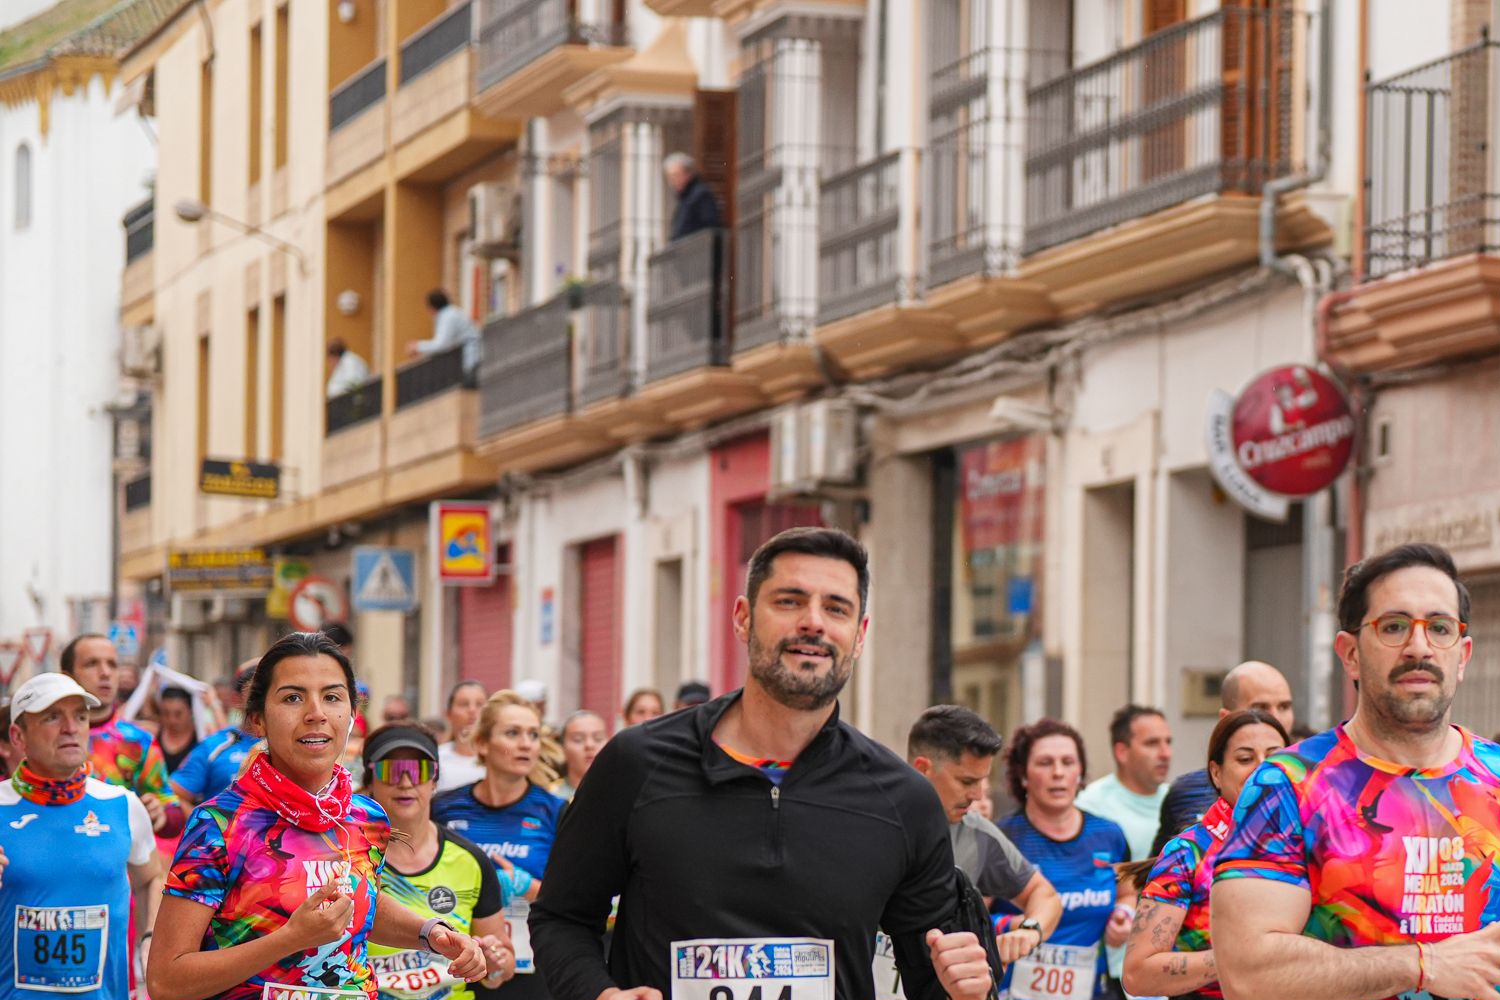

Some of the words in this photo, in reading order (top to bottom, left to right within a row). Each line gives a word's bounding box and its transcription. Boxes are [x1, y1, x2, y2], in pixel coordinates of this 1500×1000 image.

[1402, 836, 1438, 874] XII
[1439, 836, 1465, 860] 08
[1404, 875, 1440, 893] MEDIA
[1440, 873, 1465, 886] 2026
[1402, 890, 1464, 913] MARATÓN
[27, 910, 57, 930] 21K
[1409, 915, 1432, 934] 10K
[1434, 923, 1464, 933] LUCENA
[34, 934, 86, 965] 845
[696, 946, 746, 978] 21K
[387, 968, 441, 992] 269
[1030, 967, 1075, 995] 208
